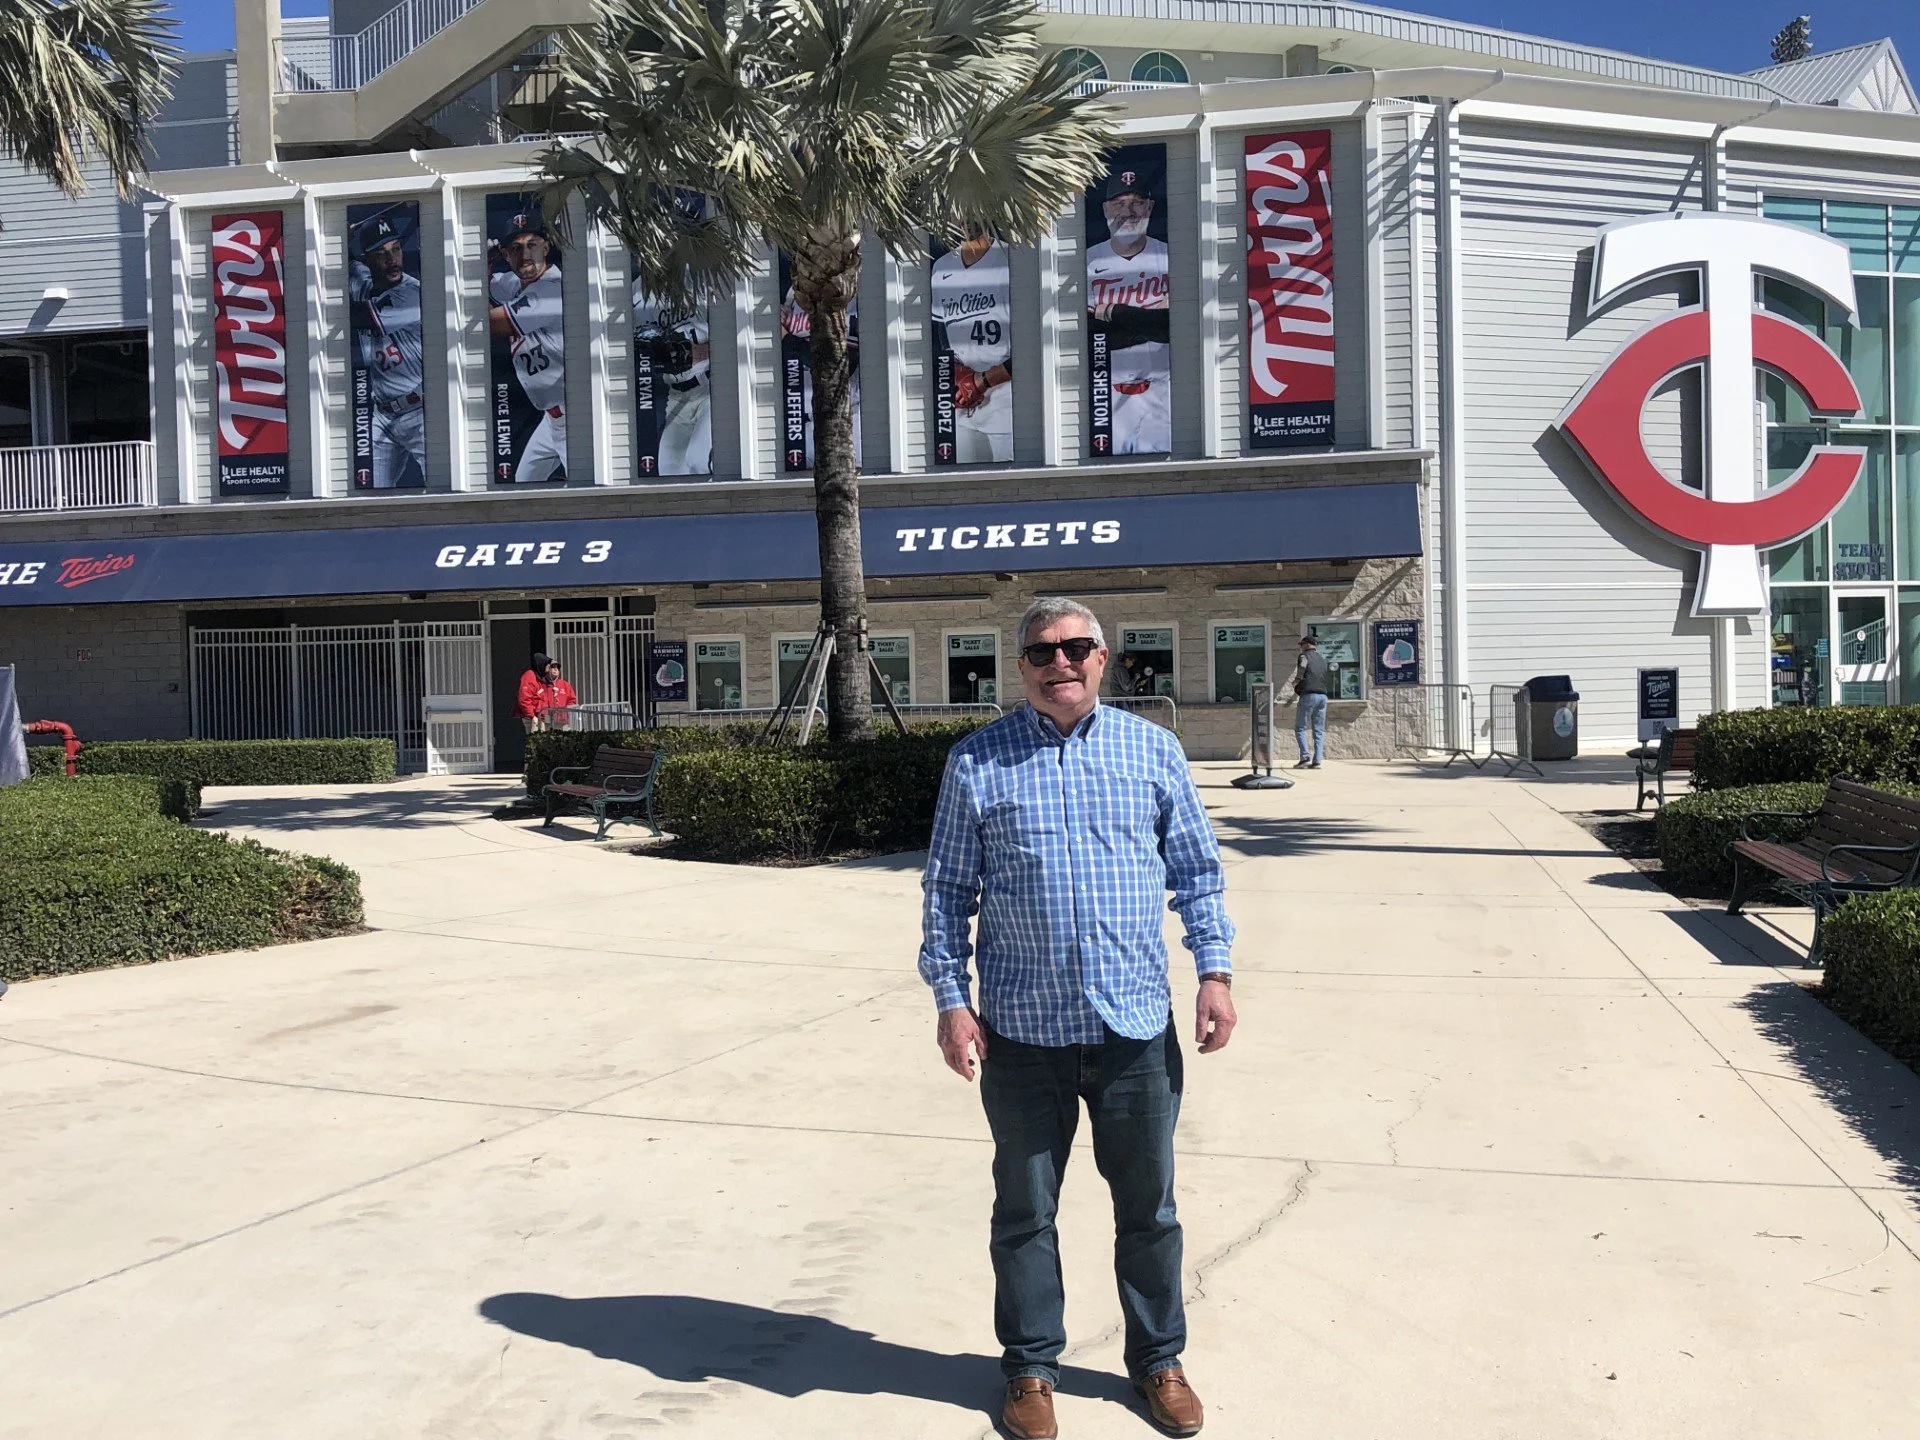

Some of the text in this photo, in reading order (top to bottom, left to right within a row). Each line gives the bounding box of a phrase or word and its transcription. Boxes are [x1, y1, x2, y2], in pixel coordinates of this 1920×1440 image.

[960, 291, 996, 314] Cities
[970, 319, 1002, 346] 49
[375, 341, 405, 372] 25
[519, 344, 550, 377] 23
[638, 353, 653, 410] JOE RYAN
[1093, 333, 1109, 427] DEREK SHELTON
[787, 359, 803, 441] RYAN JEFFERS
[937, 355, 955, 434] PABLO LÓPEZ
[355, 369, 370, 457] BYRON BUXTON
[497, 383, 511, 456] ROYCE LEWIS
[1264, 414, 1331, 427] LEE HEALTH
[1260, 427, 1326, 437] SPORTS COMPLEX
[230, 466, 285, 477] LEE HEALTH
[896, 520, 1121, 552] TICKETS
[435, 540, 613, 568] GATE 3
[1838, 543, 1885, 557] TEAM
[55, 553, 135, 588] Twins
[1836, 562, 1887, 577] STORE
[951, 638, 961, 649] 5
[1126, 632, 1137, 644] 3
[1217, 630, 1227, 641] 2
[76, 648, 92, 661] FDC
[698, 644, 708, 656] 8
[781, 642, 791, 654] 7
[1646, 680, 1671, 697] Twins
